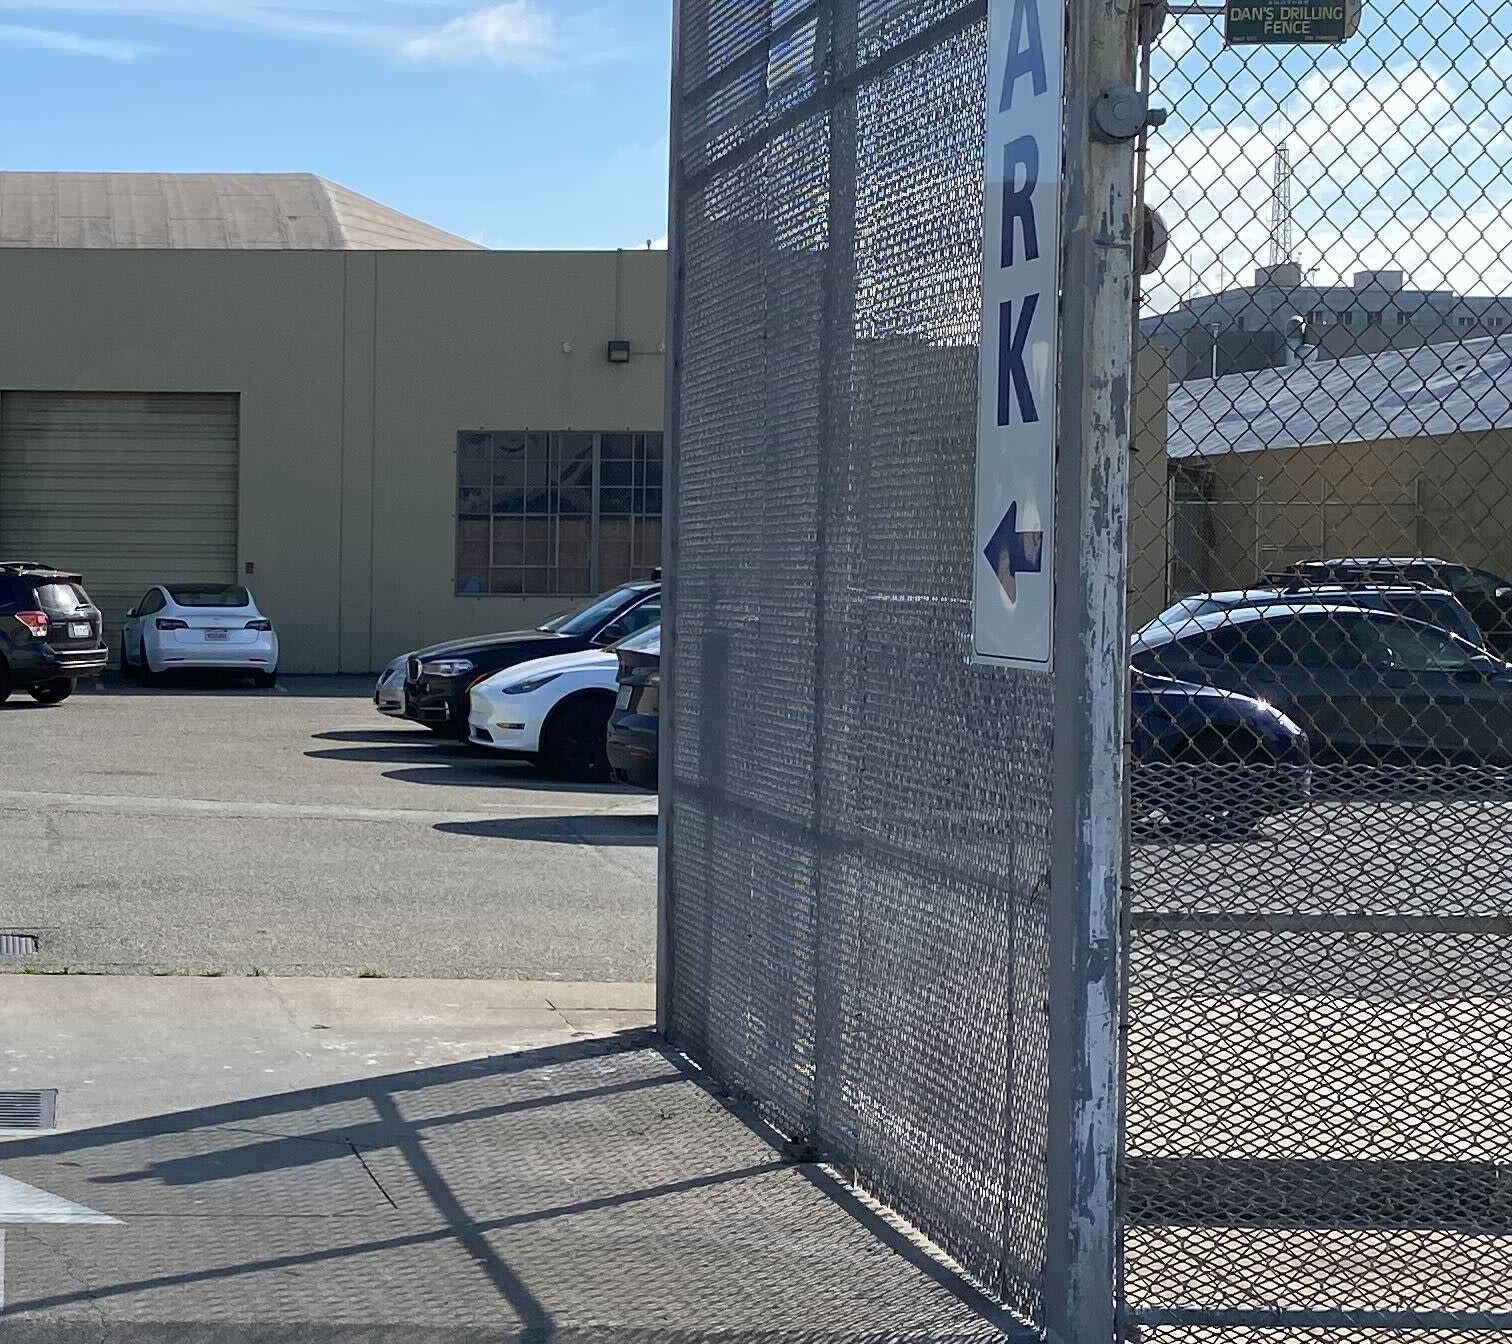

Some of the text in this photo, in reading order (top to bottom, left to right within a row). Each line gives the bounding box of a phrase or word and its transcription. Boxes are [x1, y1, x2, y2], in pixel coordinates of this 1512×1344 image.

[1230, 6, 1343, 22] DAN'S DRILLING
[1264, 21, 1311, 34] FENCE
